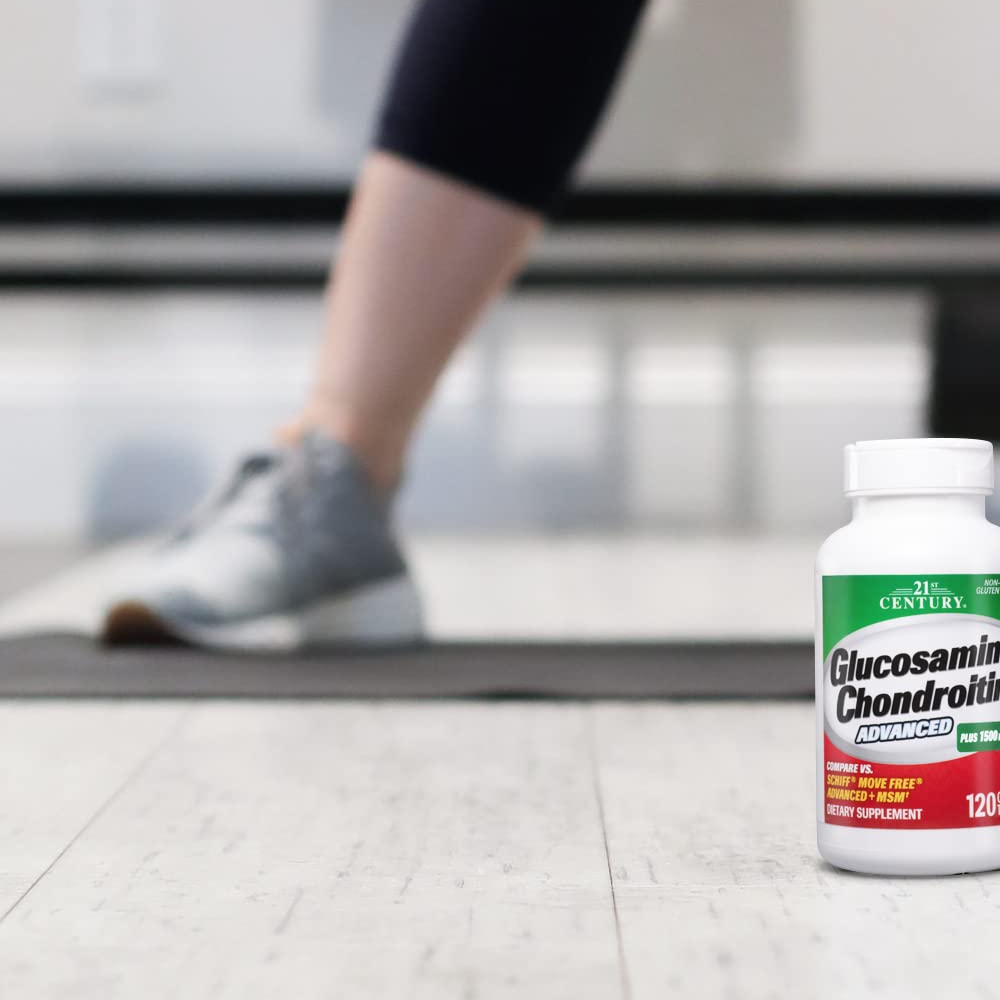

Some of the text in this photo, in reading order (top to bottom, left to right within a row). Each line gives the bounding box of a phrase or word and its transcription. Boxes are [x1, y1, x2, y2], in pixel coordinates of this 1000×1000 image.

[975, 586, 999, 595] GLUTEN
[854, 716, 955, 745] ADVANCED
[960, 732, 978, 743] PLUS
[826, 761, 874, 774] COMPARE VS.
[858, 778, 888, 789] MOVE
[826, 787, 866, 801] ADVANCED
[826, 803, 923, 820] DIETARY SUPPLEMENT
[966, 792, 997, 818] 120
